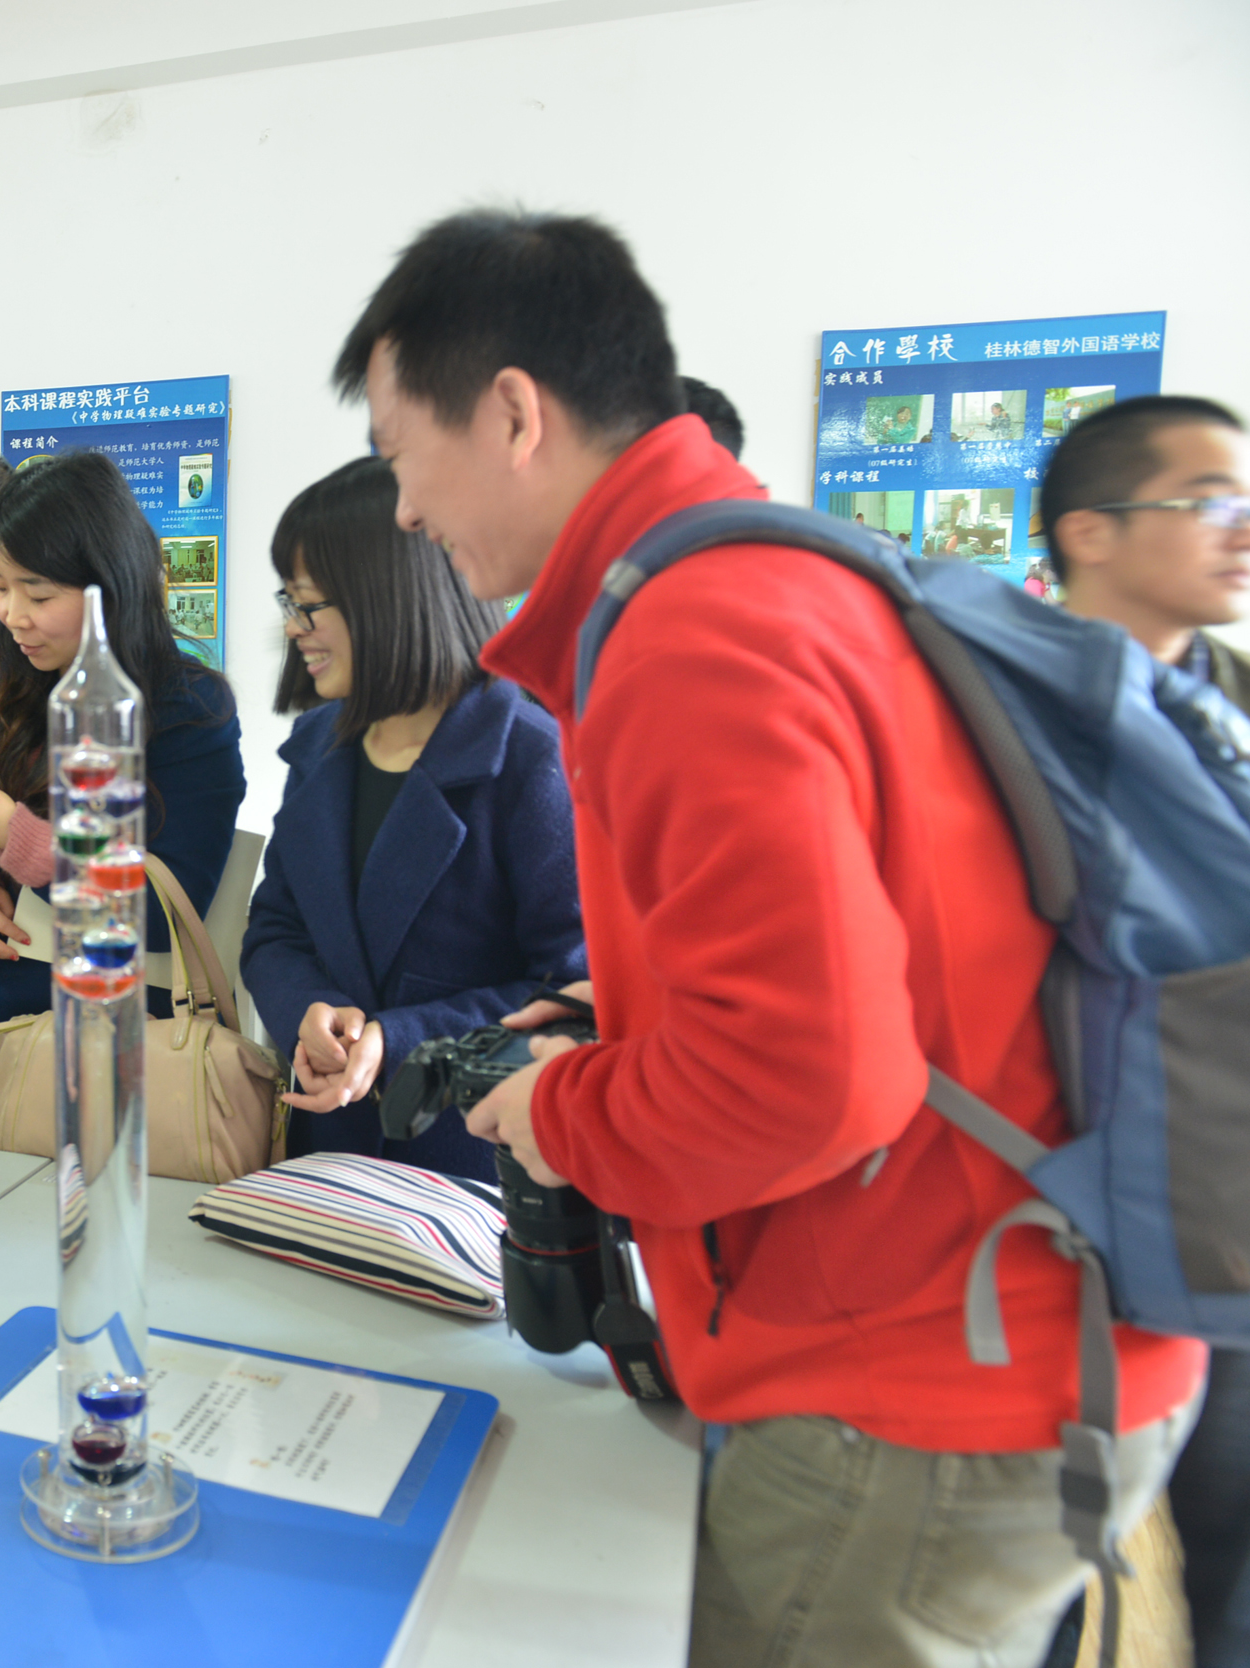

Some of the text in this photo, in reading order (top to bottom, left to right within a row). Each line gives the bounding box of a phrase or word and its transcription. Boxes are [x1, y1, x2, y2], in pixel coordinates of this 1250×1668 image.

[983, 331, 1162, 359] 桂林德智外国语学校
[823, 369, 885, 387] 实践成员
[3, 385, 151, 413] 本科课程实践平台
[71, 401, 226, 424] 《中学物理疑难实验专题研究》
[9, 435, 59, 449] 课程简介
[819, 470, 880, 485] 学科课程
